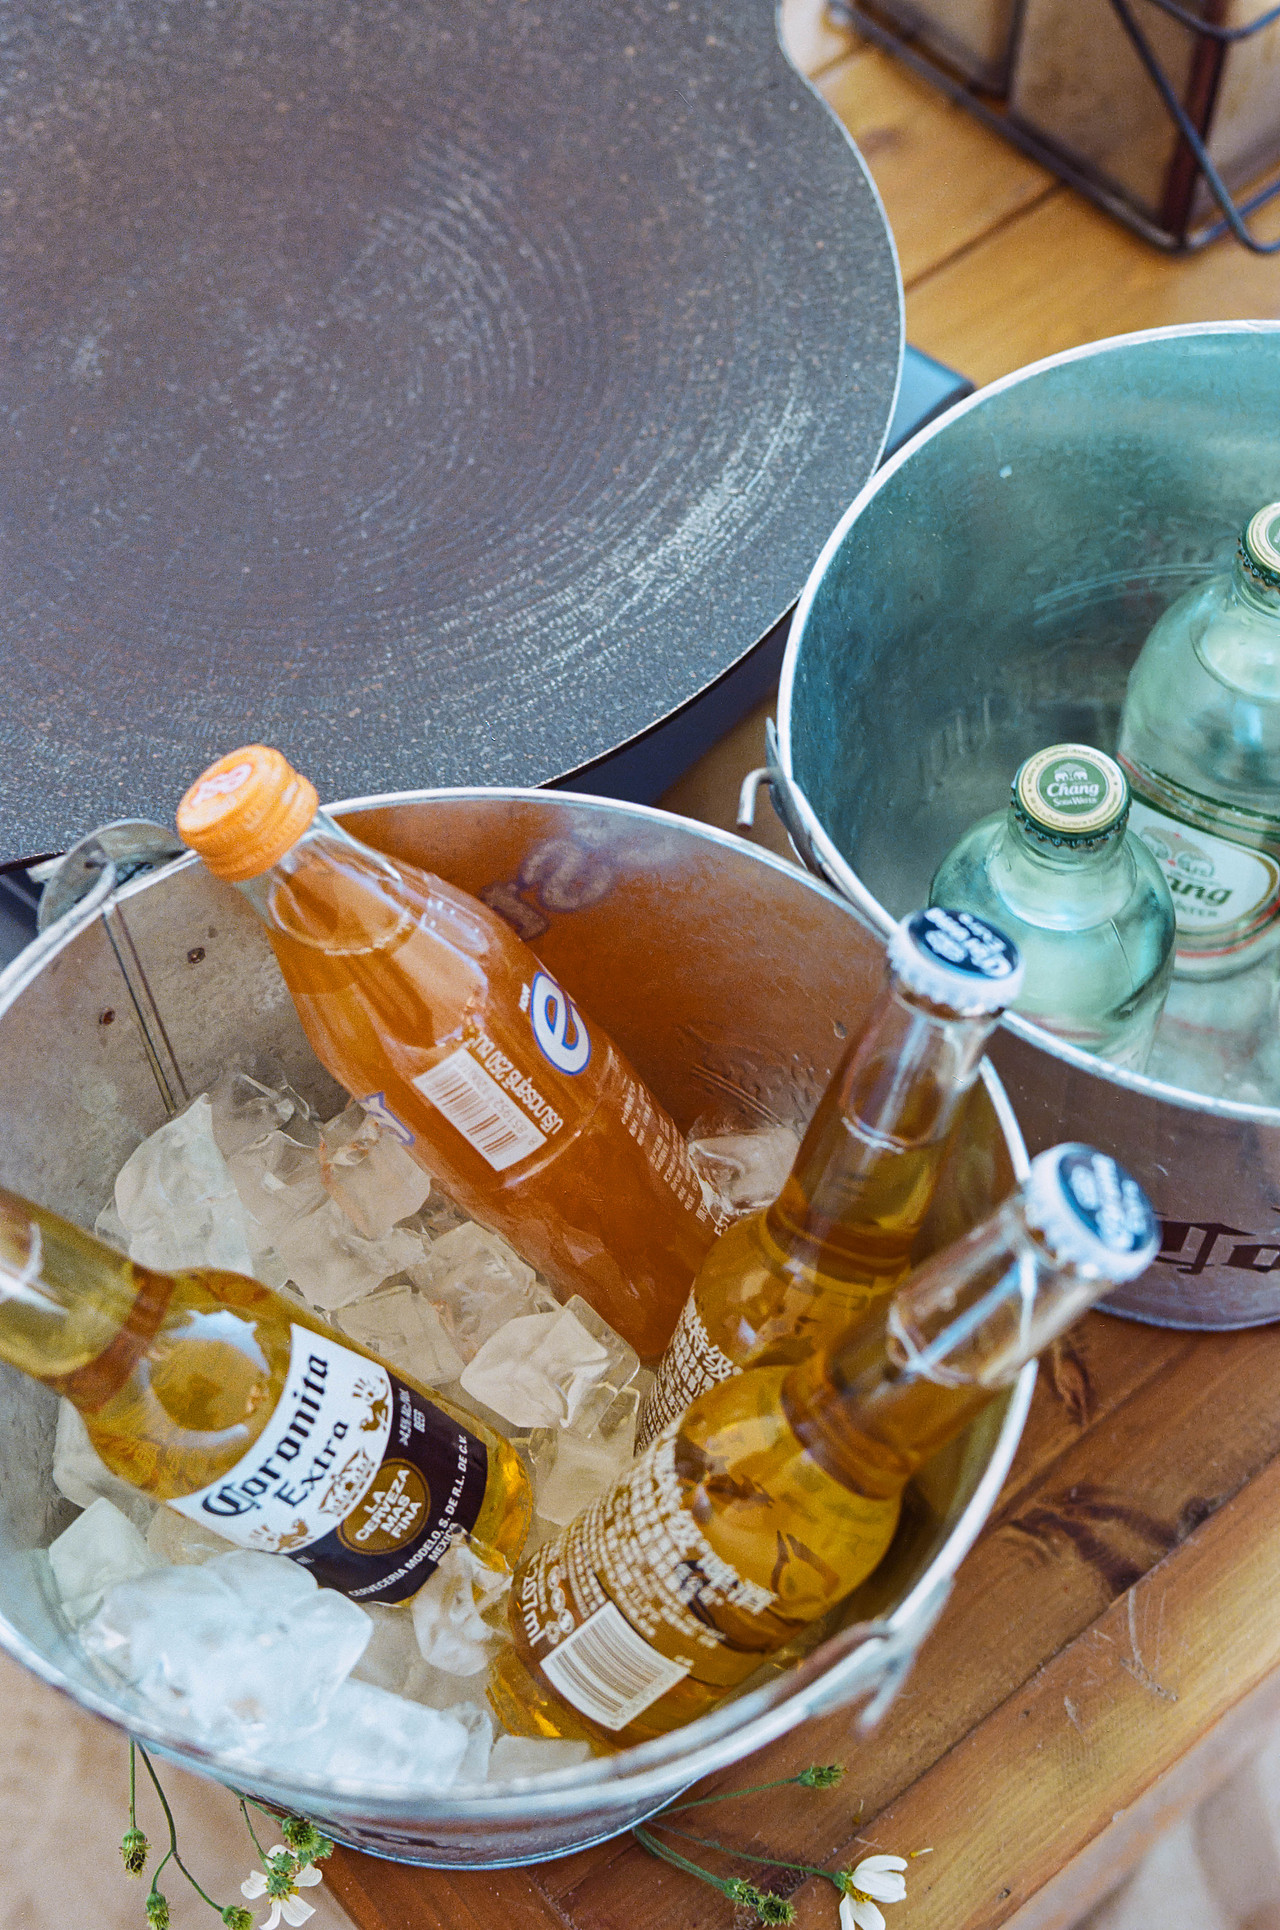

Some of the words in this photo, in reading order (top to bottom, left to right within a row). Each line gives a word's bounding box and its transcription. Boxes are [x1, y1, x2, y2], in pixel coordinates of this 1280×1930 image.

[1046, 782, 1100, 797] Chang
[484, 1050, 515, 1081] 250
[202, 1354, 328, 1517] Coronita
[273, 1419, 349, 1508] Extra
[457, 1454, 468, 1473] DE
[452, 1475, 466, 1497] R.L.
[355, 1469, 410, 1541] CERVEZA
[363, 1491, 386, 1514] LA
[380, 1494, 411, 1532] MAS
[444, 1497, 459, 1516] DE
[390, 1502, 422, 1539] FINA
[438, 1517, 451, 1529] S.
[404, 1530, 445, 1570] MODELO,
[348, 1568, 409, 1597] CERVECERIA
